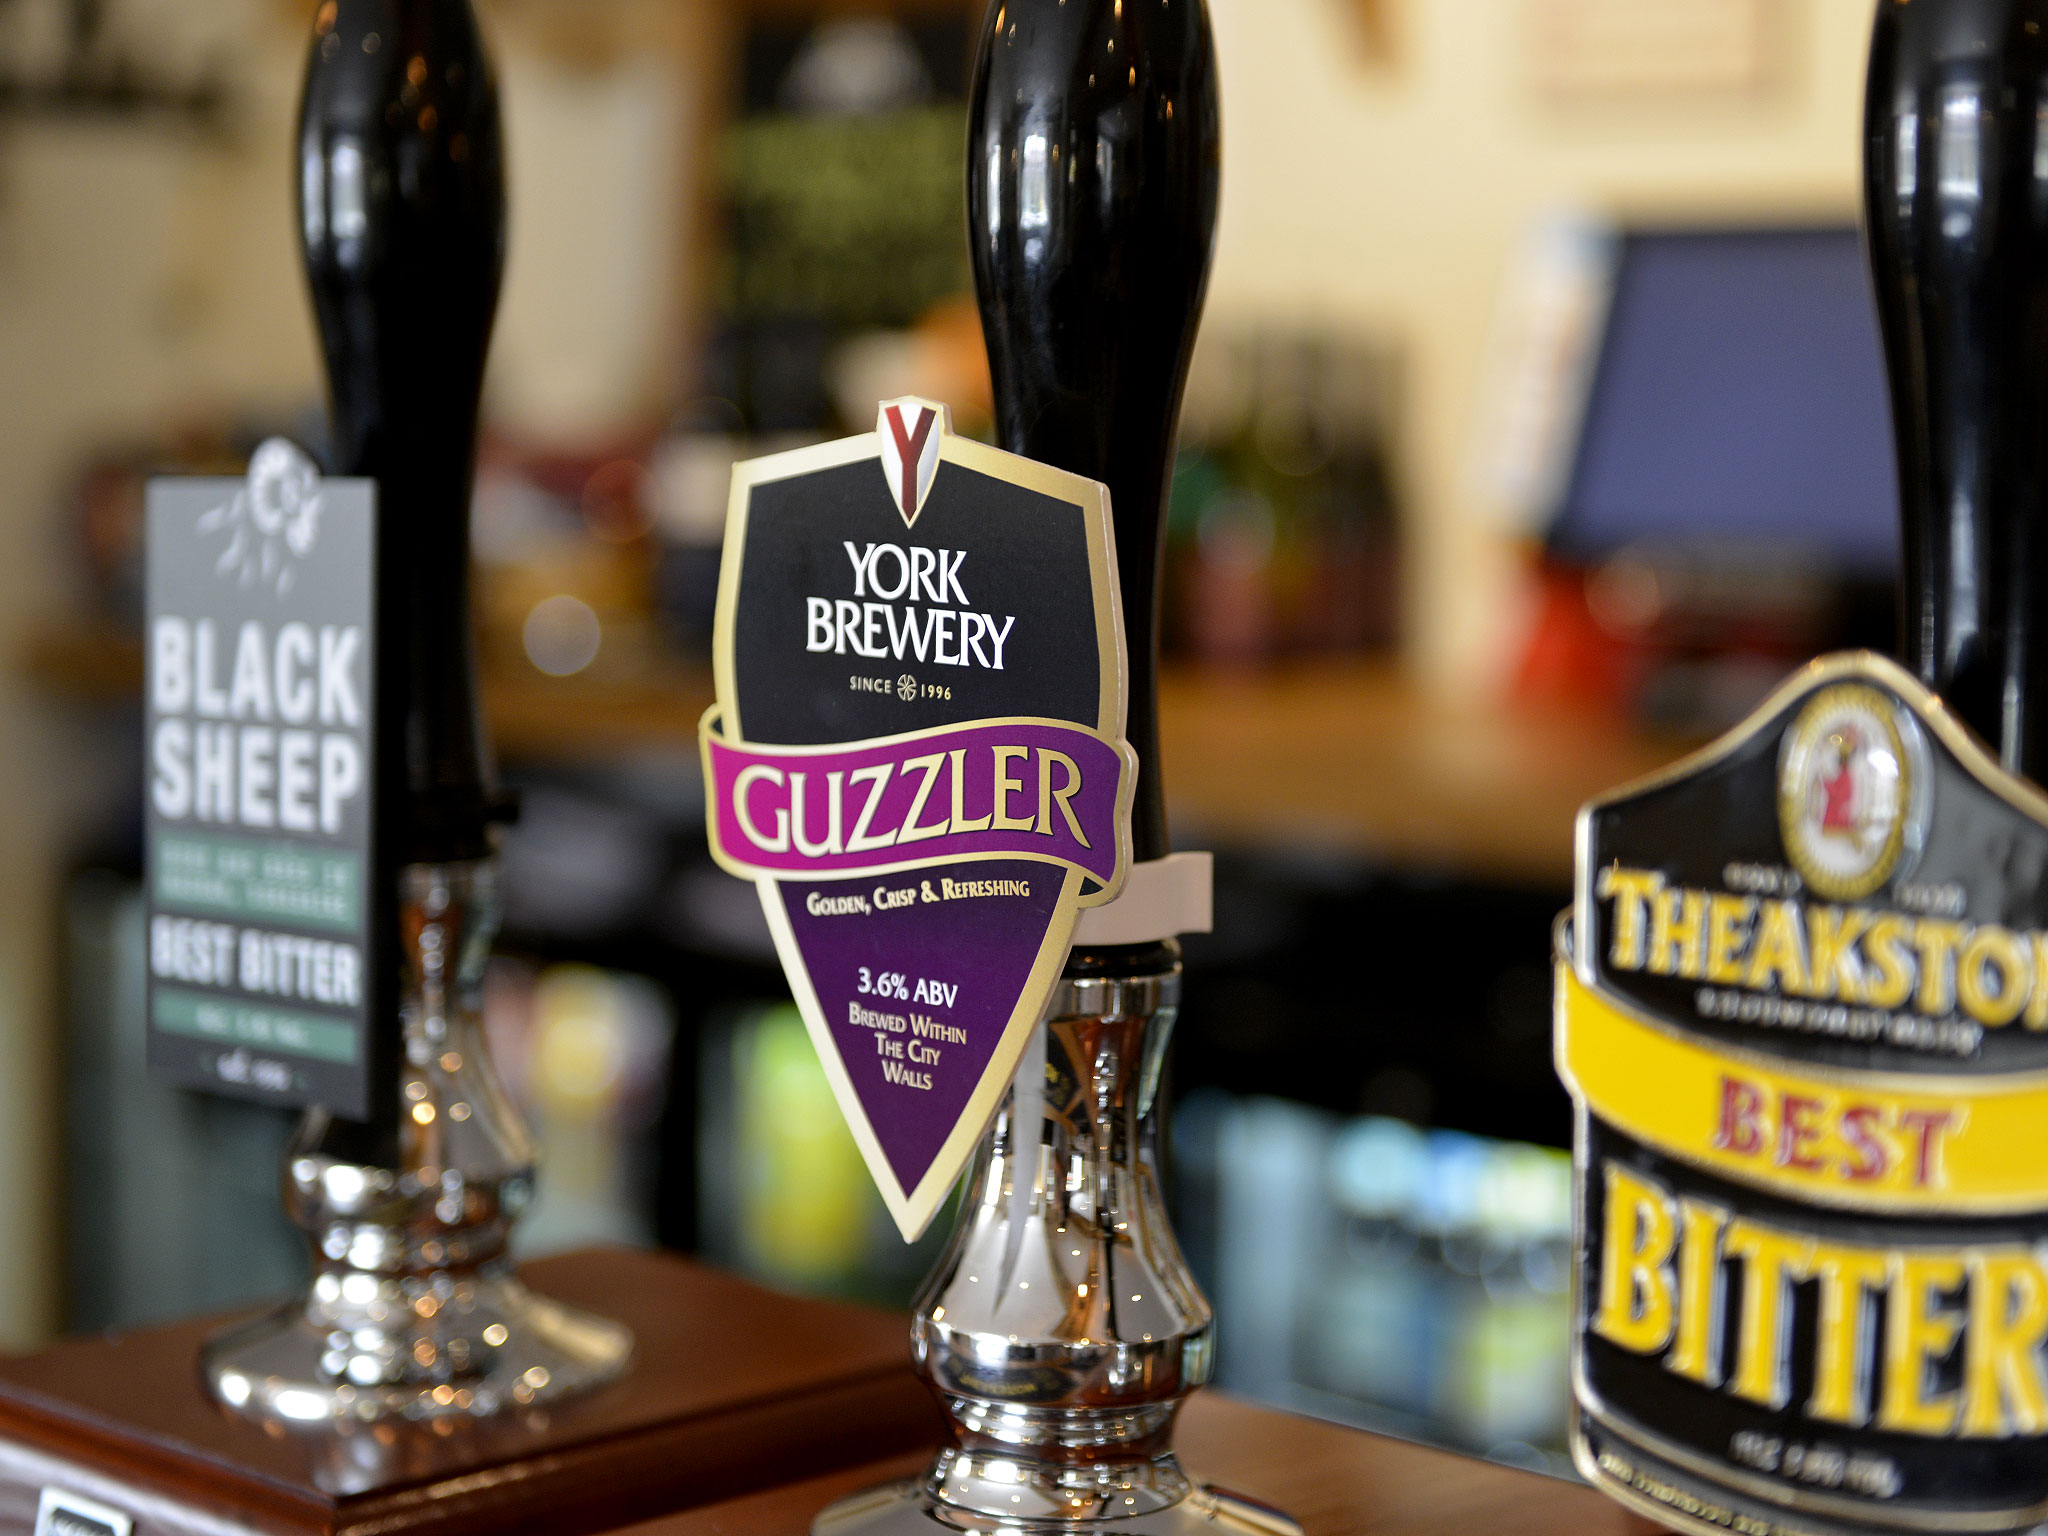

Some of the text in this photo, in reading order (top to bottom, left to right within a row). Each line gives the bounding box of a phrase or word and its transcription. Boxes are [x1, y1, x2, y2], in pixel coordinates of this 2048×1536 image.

[885, 404, 937, 521] Y
[843, 540, 970, 605] YORK
[806, 596, 1015, 670] BREWERY
[153, 616, 361, 726] BLACK
[849, 674, 951, 701] SINCE 1996
[152, 717, 361, 834] SHEEP
[733, 745, 1092, 858] GUZZLER
[806, 877, 1030, 917] GOLDEN, CRISP & REFRESHING
[151, 914, 362, 1006] BEST BITTER
[857, 966, 959, 1009] 3.6% ABV
[848, 1000, 968, 1046] BREWED WITHIN
[874, 1031, 942, 1067] THE CITY
[881, 1059, 933, 1091] WALLS
[1713, 1074, 1968, 1190] BEST
[1590, 1162, 2048, 1438] BITTER
